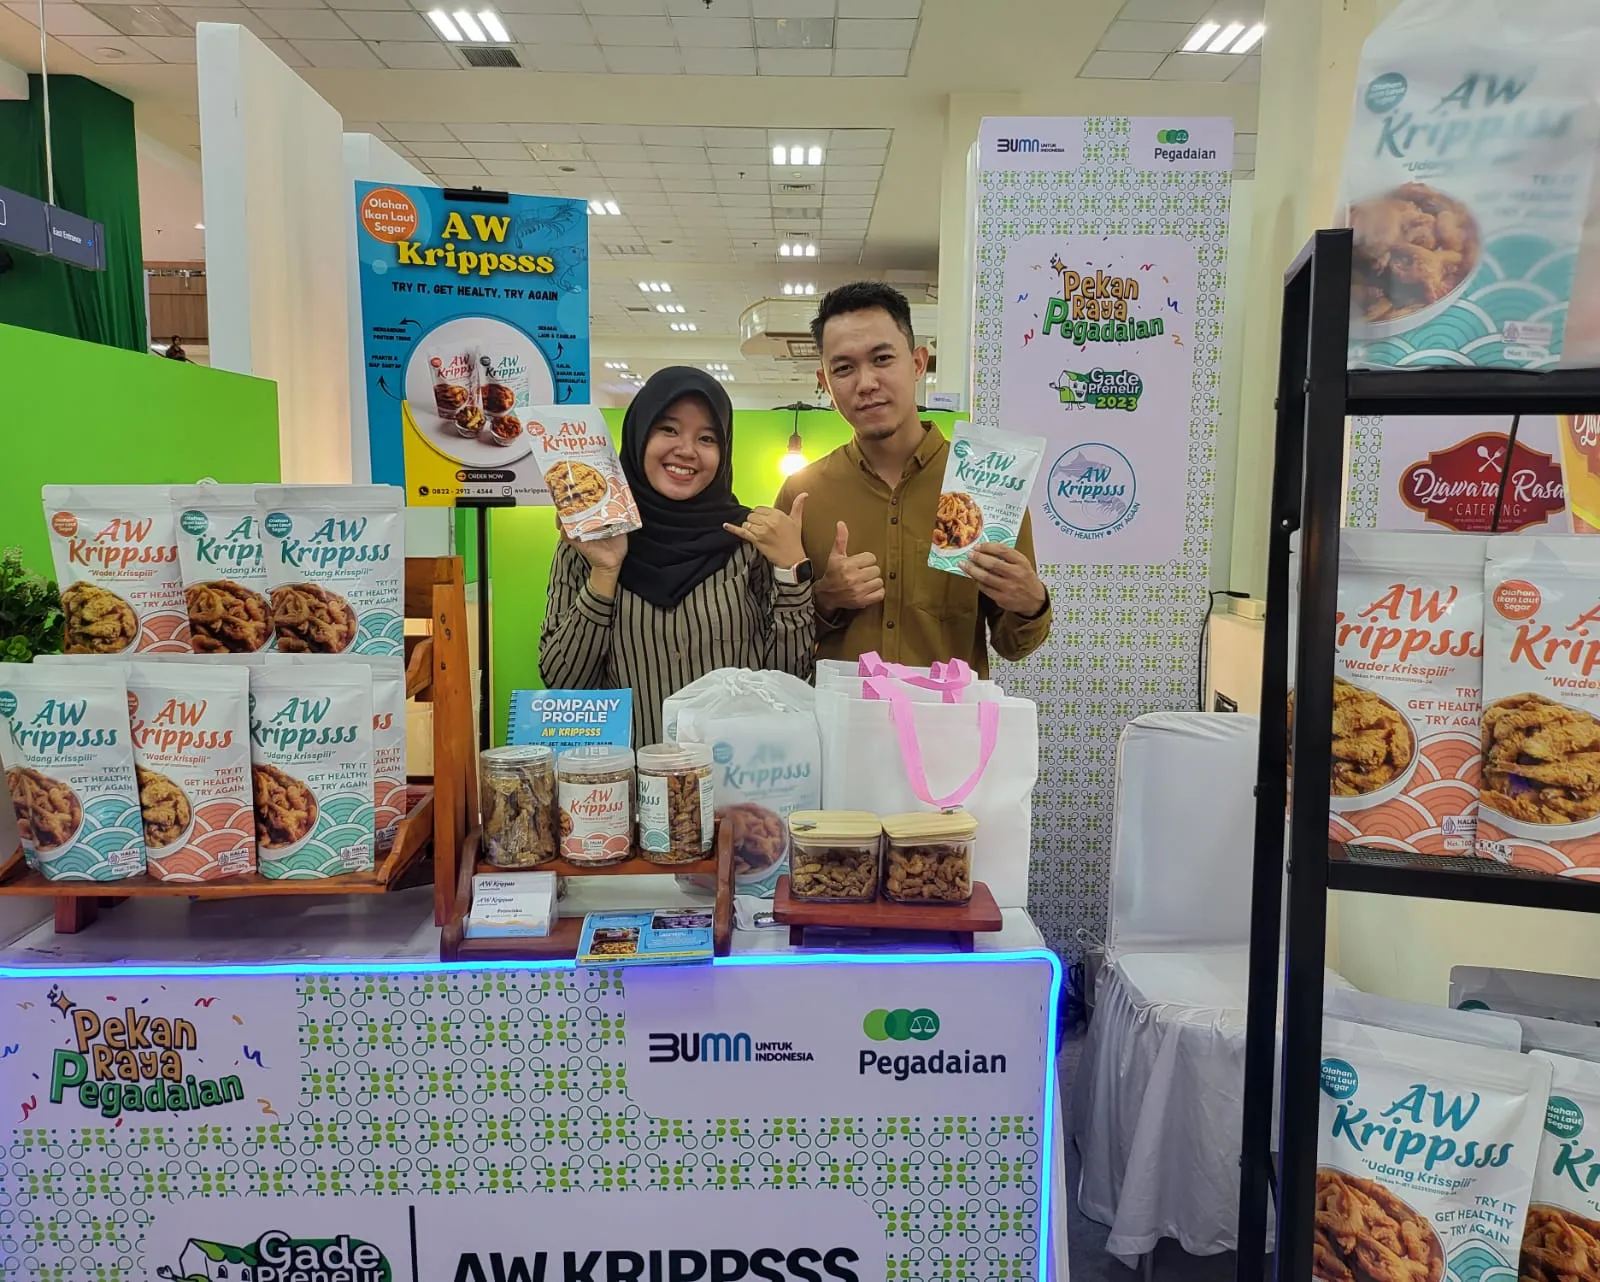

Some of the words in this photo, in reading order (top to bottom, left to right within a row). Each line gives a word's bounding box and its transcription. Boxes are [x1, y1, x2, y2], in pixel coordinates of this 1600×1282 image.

[997, 138, 1040, 153] BUMN
[1154, 147, 1216, 163] Pegadaian
[369, 197, 409, 211] Olahan
[365, 207, 388, 220] Ikan
[390, 211, 415, 223] Laut
[374, 222, 407, 235] Segar
[442, 212, 511, 243] AW
[63, 229, 82, 245] Entrance
[397, 240, 554, 276] Krippsss
[392, 281, 413, 292] TRY
[434, 284, 453, 295] GET
[504, 288, 523, 299] TRY
[528, 289, 558, 301] AGAIN
[1063, 269, 1140, 300] Pekan
[1072, 294, 1128, 322] Raya
[1042, 297, 1164, 345] Pegadaian
[1090, 367, 1140, 386] Gade
[1088, 383, 1140, 394] Preneur
[1095, 396, 1138, 411] 2023
[559, 421, 586, 436] AW
[542, 433, 607, 453] Krippsss
[975, 451, 1016, 472] AW
[955, 458, 1027, 491] Krippsss
[1076, 466, 1112, 483] AW
[1058, 480, 1126, 499] Krippsss
[1412, 469, 1500, 504] Djawara
[1511, 470, 1565, 503] Rasa
[1041, 502, 1052, 514] TRY
[1456, 503, 1521, 516] CATERNG
[1112, 524, 1124, 534] TRY
[1124, 502, 1141, 525] AGAIN
[93, 518, 152, 542] AW
[310, 517, 367, 543] AW
[1060, 525, 1074, 536] GET
[1074, 532, 1105, 540] HEALTHY
[69, 538, 178, 569] Krippsss
[281, 539, 391, 568] Krippsss
[366, 588, 399, 596] HEALTHY
[1518, 596, 1539, 604] Laut
[376, 597, 398, 605] AGAIN
[1358, 583, 1458, 623] AW
[1504, 603, 1531, 612] Segar
[1456, 688, 1480, 698] TRY
[30, 699, 88, 726] AW
[152, 698, 208, 727] AW
[270, 697, 331, 724] AW
[531, 699, 620, 712] COMPANY
[1408, 700, 1433, 710] GET
[542, 711, 607, 723] PROFILE
[1425, 715, 1449, 725] TRY
[8, 720, 117, 754] Krippsss
[251, 719, 358, 751] Krippsss
[541, 728, 556, 737] AW
[558, 728, 601, 737] KRIPPSSS
[376, 749, 391, 757] TRY
[215, 768, 232, 776] TRY
[307, 774, 325, 782] GET
[328, 772, 368, 781] HEALTHY
[375, 766, 400, 774] AGAIN
[723, 763, 811, 789] Krippsss
[70, 776, 92, 784] GET
[94, 775, 133, 783] HEALTHY
[203, 776, 244, 786] HEALTHY
[339, 781, 368, 789] AGAIN
[196, 788, 213, 796] TRY
[215, 786, 244, 795] AGAIN
[584, 787, 613, 802] AW
[571, 800, 623, 816] Krippsss
[70, 1006, 197, 1054] Pekan
[649, 1032, 751, 1063] BUMN
[755, 1042, 792, 1051] UNTUK
[92, 1044, 182, 1083] Raya
[755, 1052, 814, 1062] INDONESIA
[859, 1050, 1007, 1080] Pegadaian
[1322, 1066, 1352, 1078] Olahan
[50, 1048, 244, 1119] Pegadaian
[1326, 1080, 1349, 1092] Segar
[1338, 1076, 1357, 1086] Laut
[1380, 1084, 1480, 1132] AW
[1561, 1115, 1582, 1124] Laut
[1332, 1100, 1514, 1171] Krippsss
[1475, 1196, 1499, 1207] TRY
[1502, 1201, 1517, 1215] IT
[1435, 1211, 1456, 1222] GET
[1458, 1209, 1515, 1229] HEALTHY
[1450, 1225, 1468, 1236] TRY
[1469, 1224, 1510, 1245] AGAIN
[257, 1230, 383, 1271] Gade
[453, 1252, 548, 1282] AW
[563, 1247, 860, 1282] KRIPPSSS
